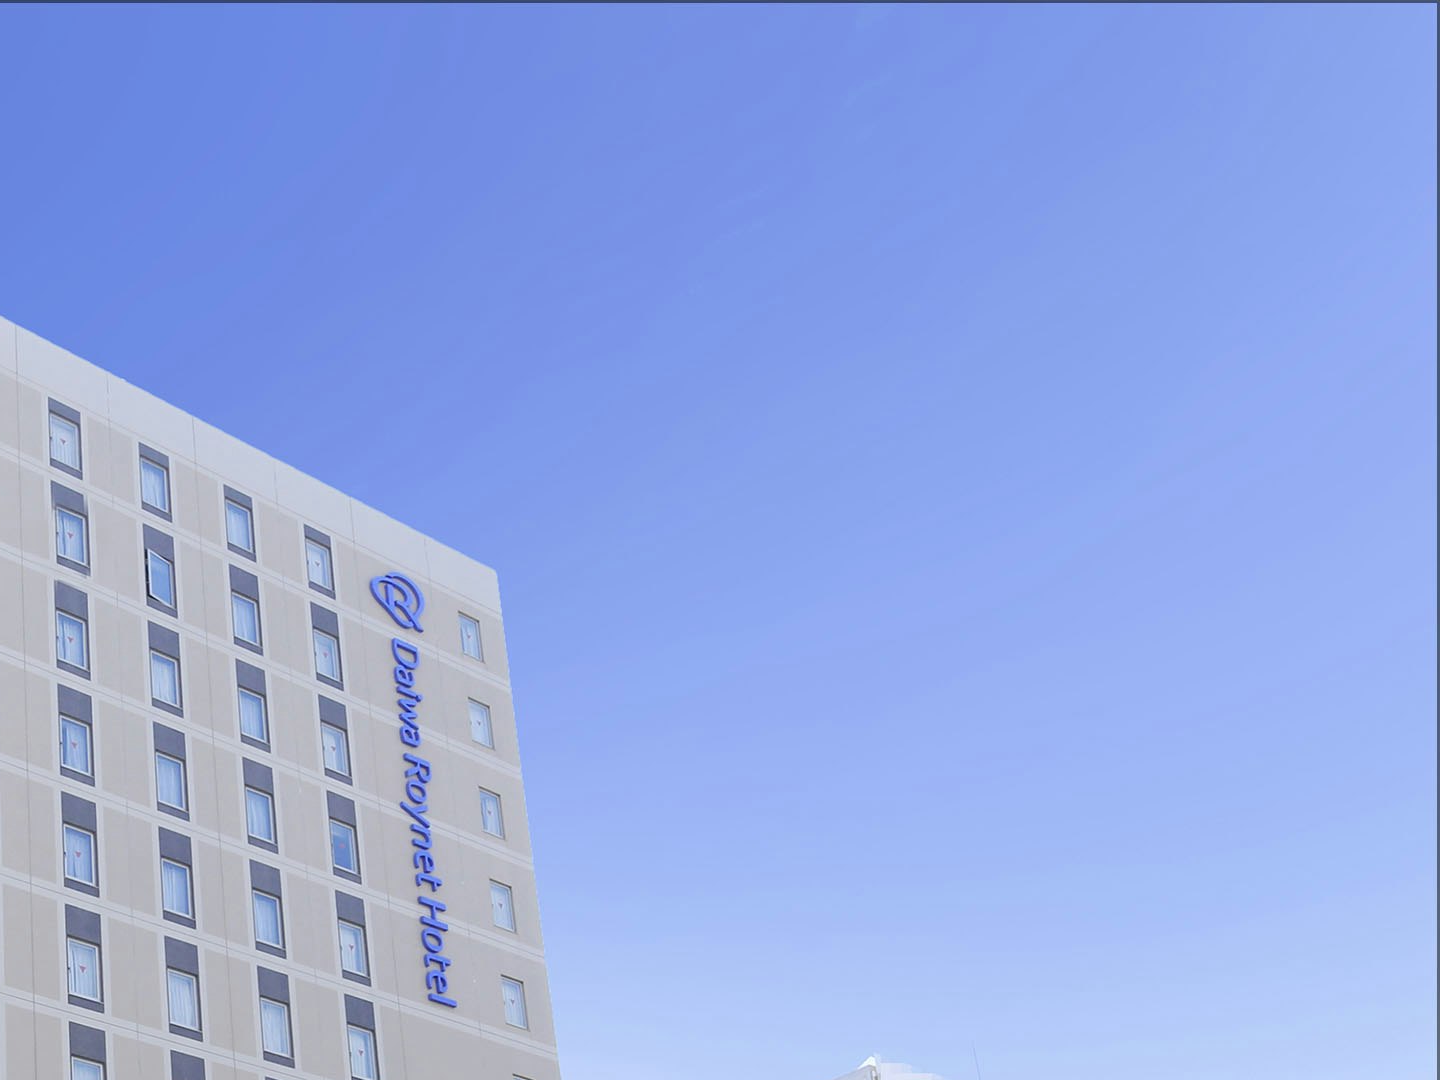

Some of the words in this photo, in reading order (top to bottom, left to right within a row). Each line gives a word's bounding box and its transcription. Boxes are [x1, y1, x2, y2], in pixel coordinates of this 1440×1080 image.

[391, 636, 423, 748] Daiwa
[400, 752, 443, 892] Roynet
[417, 896, 458, 1008] Hotel
